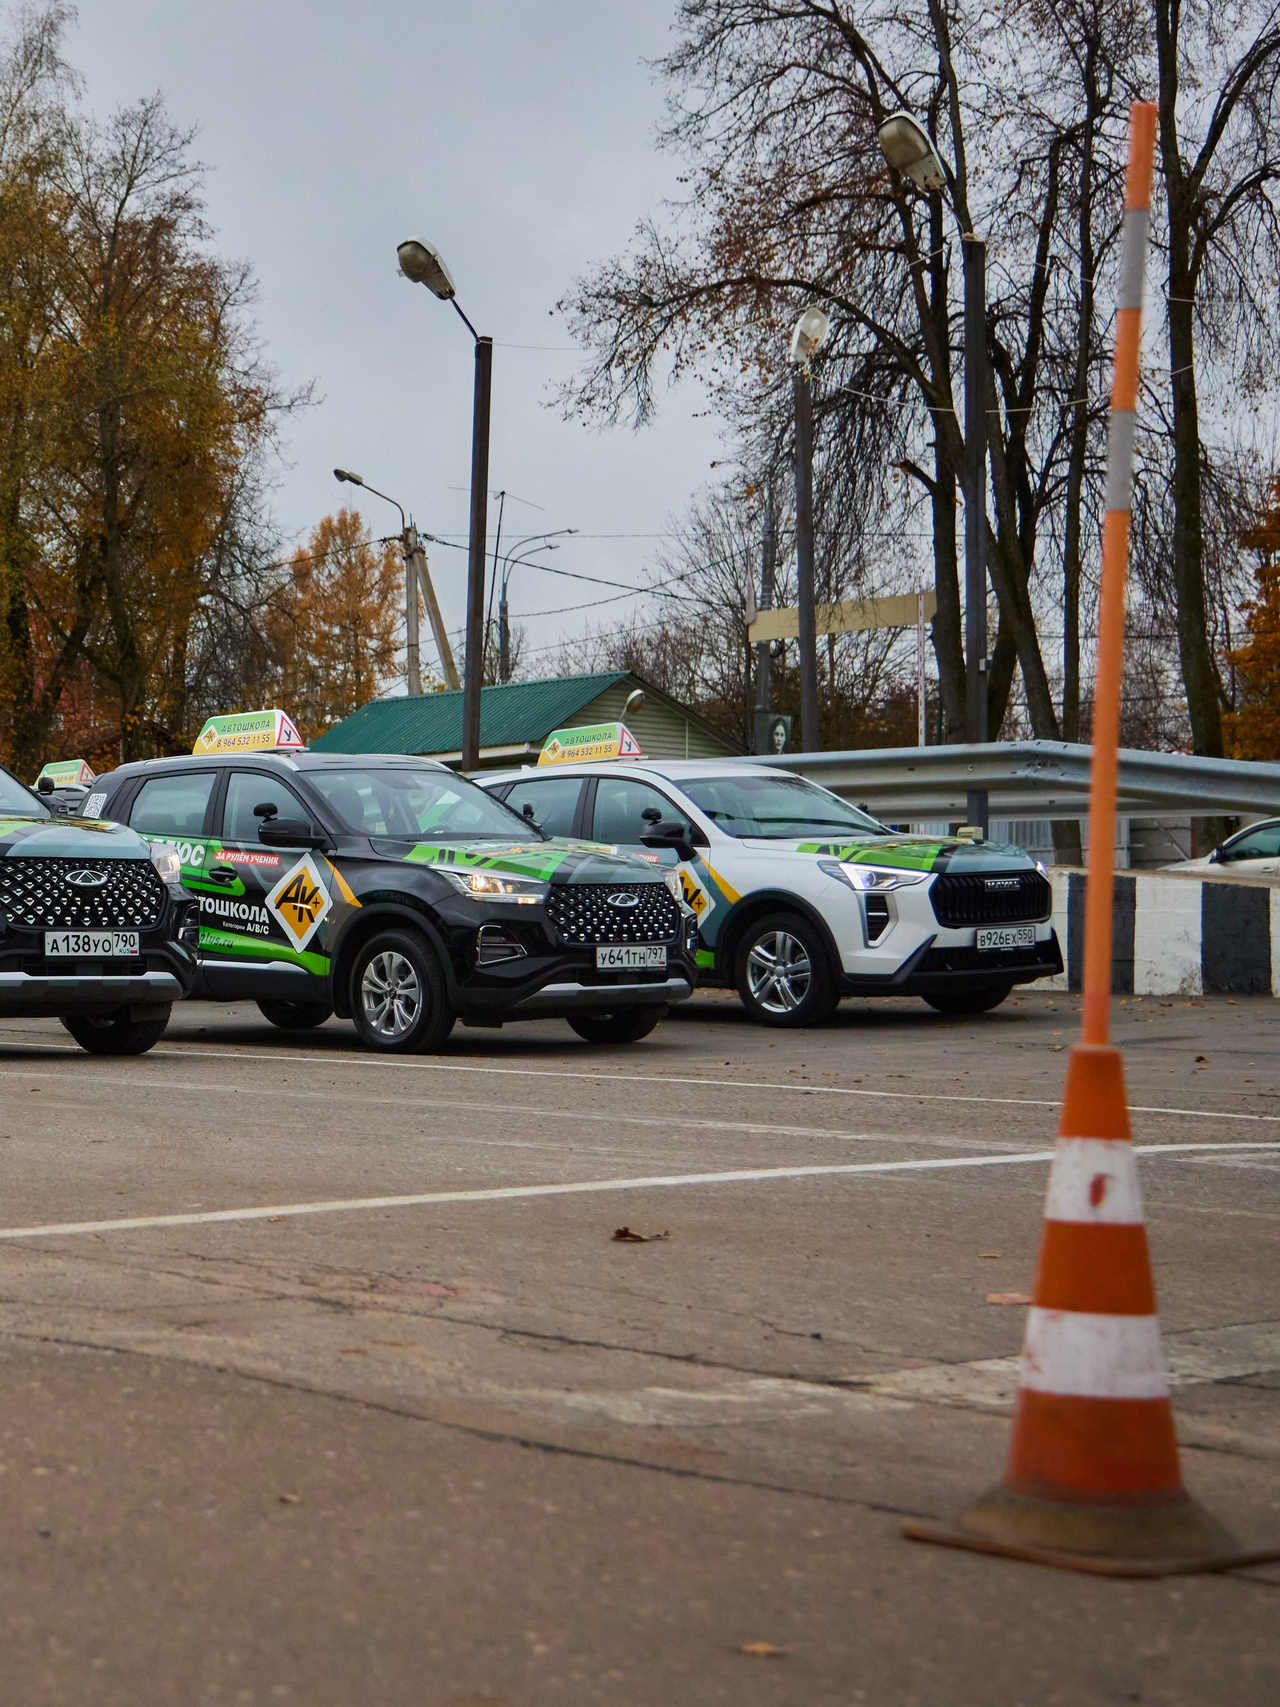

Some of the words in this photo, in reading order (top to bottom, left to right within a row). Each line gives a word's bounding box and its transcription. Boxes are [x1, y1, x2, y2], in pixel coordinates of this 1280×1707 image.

[221, 720, 271, 733] АВТОШКОЛА
[223, 738, 235, 747] 964
[237, 736, 251, 746] 532
[252, 735, 260, 744] 11
[261, 734, 271, 743] 55
[284, 729, 292, 742] У
[565, 732, 612, 745] АВТОШКОЛА
[567, 749, 579, 758] 964
[581, 747, 593, 756] 532
[595, 746, 602, 754] 11
[604, 744, 612, 753] 55
[625, 741, 632, 752] У
[153, 838, 205, 867] ЮС
[216, 852, 226, 860] ЗА
[226, 852, 249, 862] РУЛЁМ
[250, 855, 279, 865] УЧЕНИК
[198, 896, 270, 924] ТОШКОЛА
[114, 933, 136, 948] 790
[199, 932, 234, 949] plus.ru
[1018, 929, 1033, 940] 550
[647, 947, 663, 960] 797
